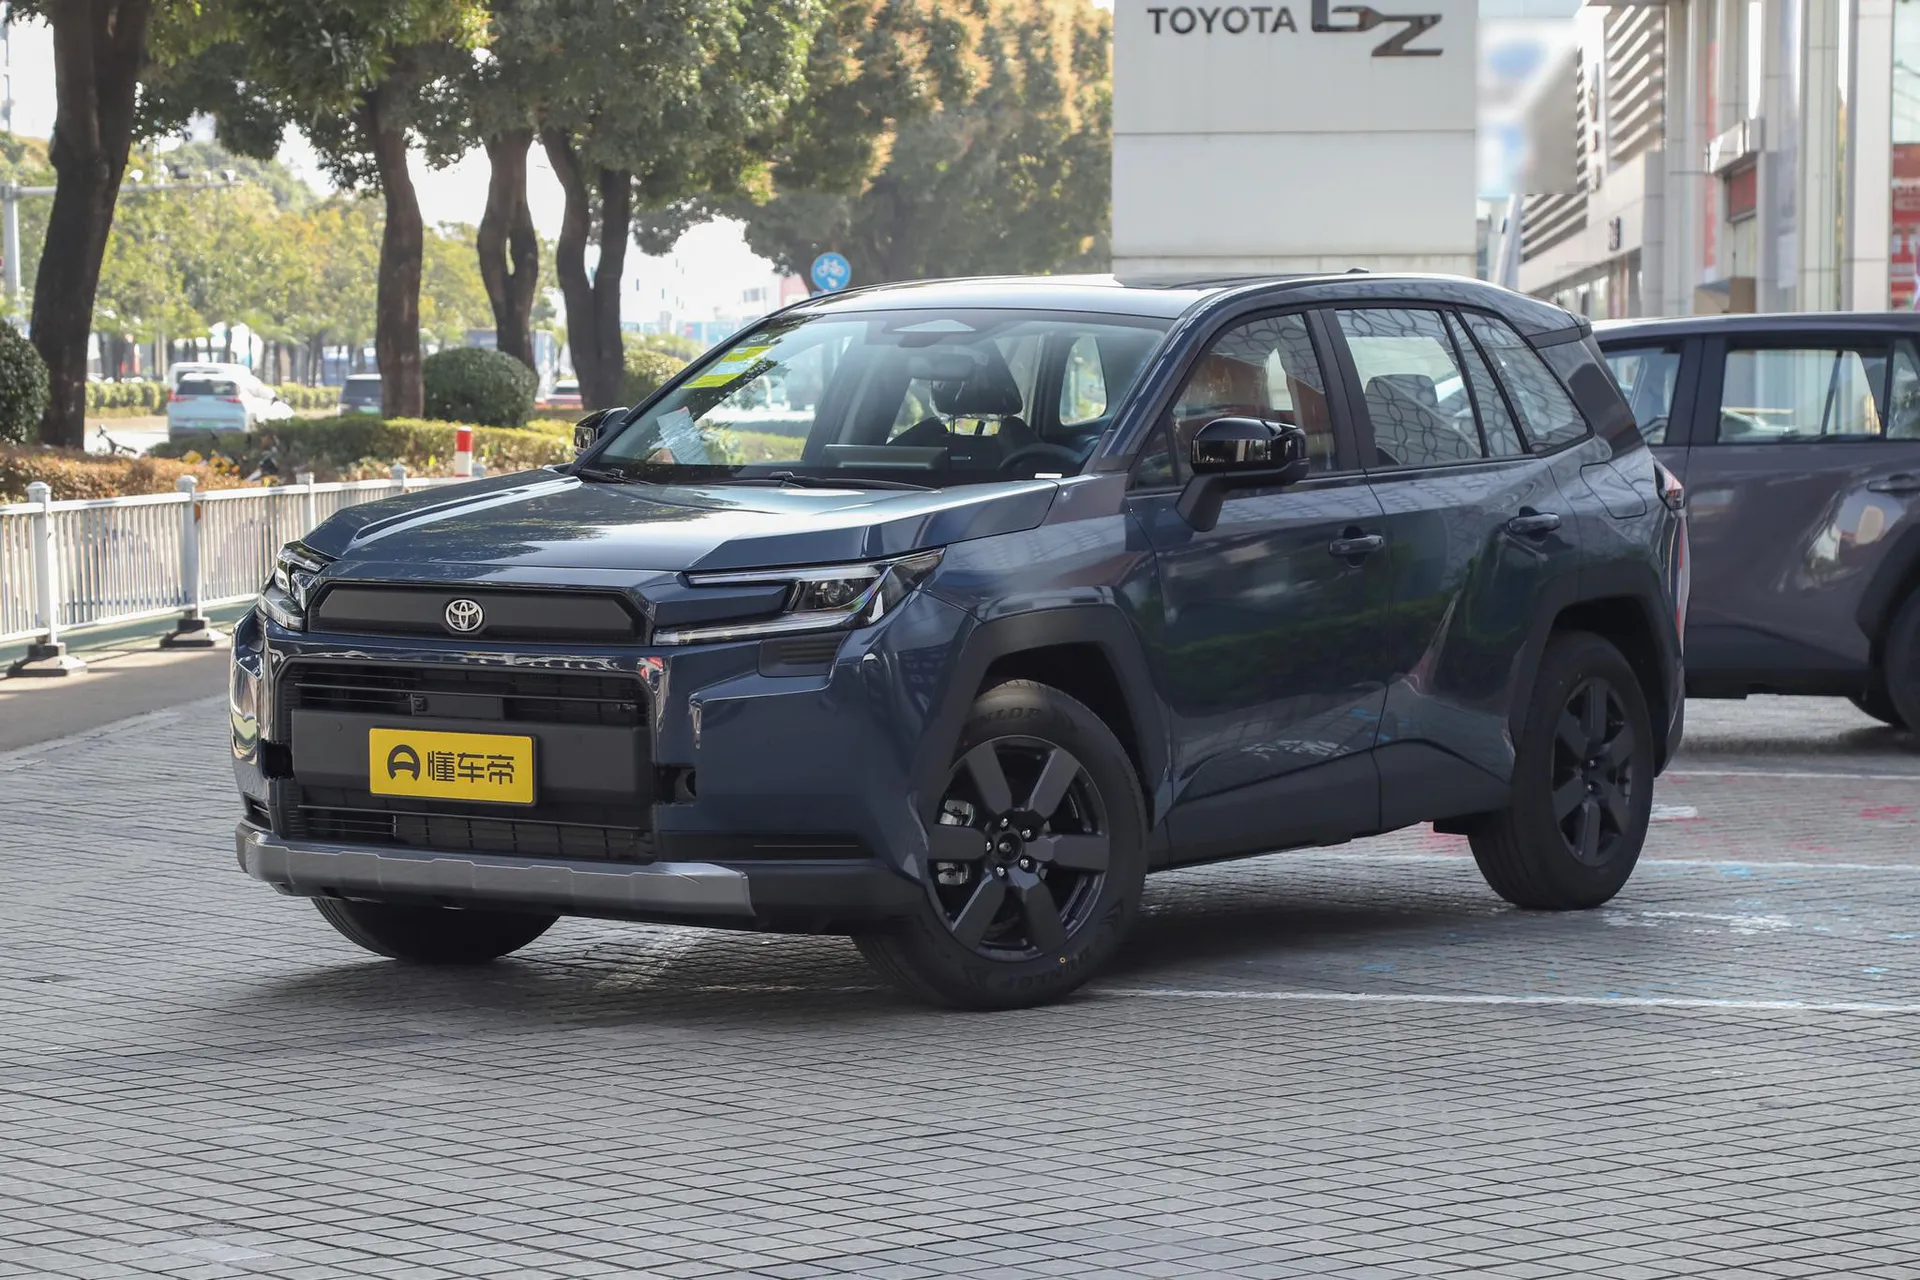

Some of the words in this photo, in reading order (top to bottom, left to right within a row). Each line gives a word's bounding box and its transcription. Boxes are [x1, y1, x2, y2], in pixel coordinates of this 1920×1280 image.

[1147, 6, 1298, 34] TOYOTA
[427, 749, 515, 786] 懂车帝
